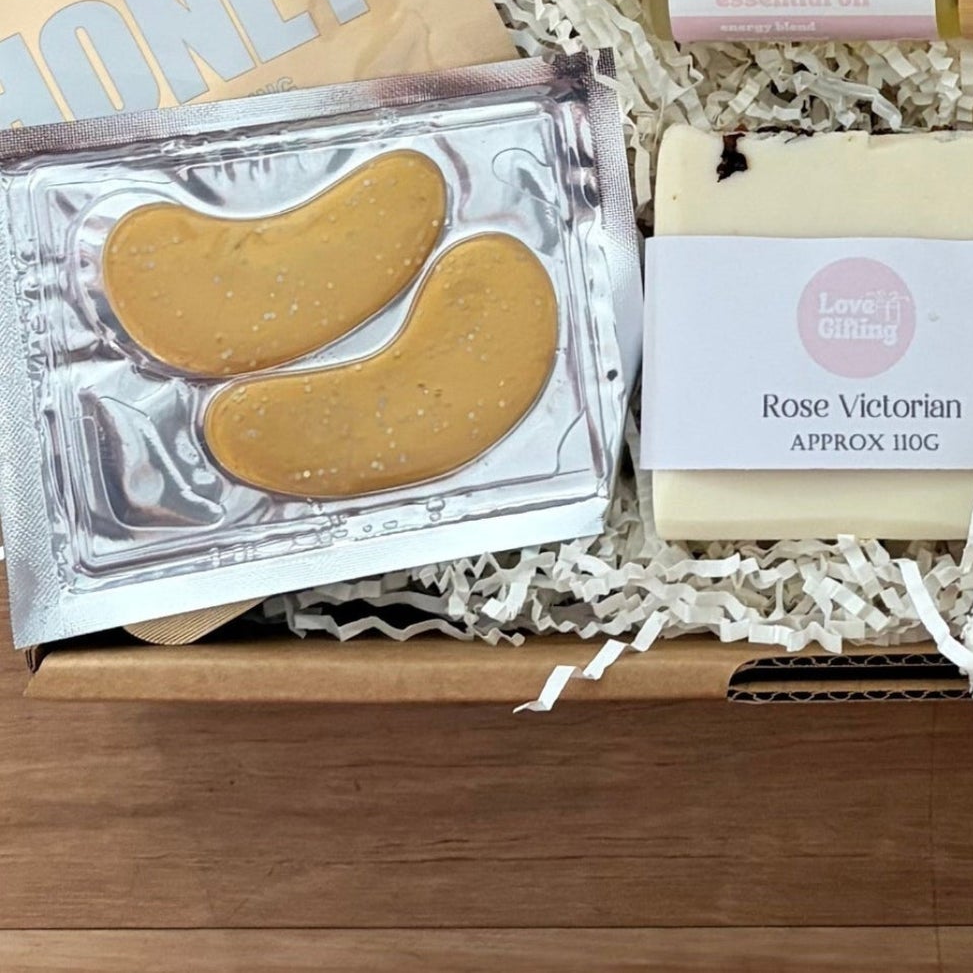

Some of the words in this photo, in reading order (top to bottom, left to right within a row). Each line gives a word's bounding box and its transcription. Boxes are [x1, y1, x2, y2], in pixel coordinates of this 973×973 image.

[720, 23, 772, 33] energy
[818, 292, 876, 315] Love
[818, 316, 899, 347] Gifting
[763, 394, 829, 418] Rose
[838, 393, 962, 419] Victorian
[791, 433, 884, 451] APPROX
[893, 433, 940, 451] 110G
